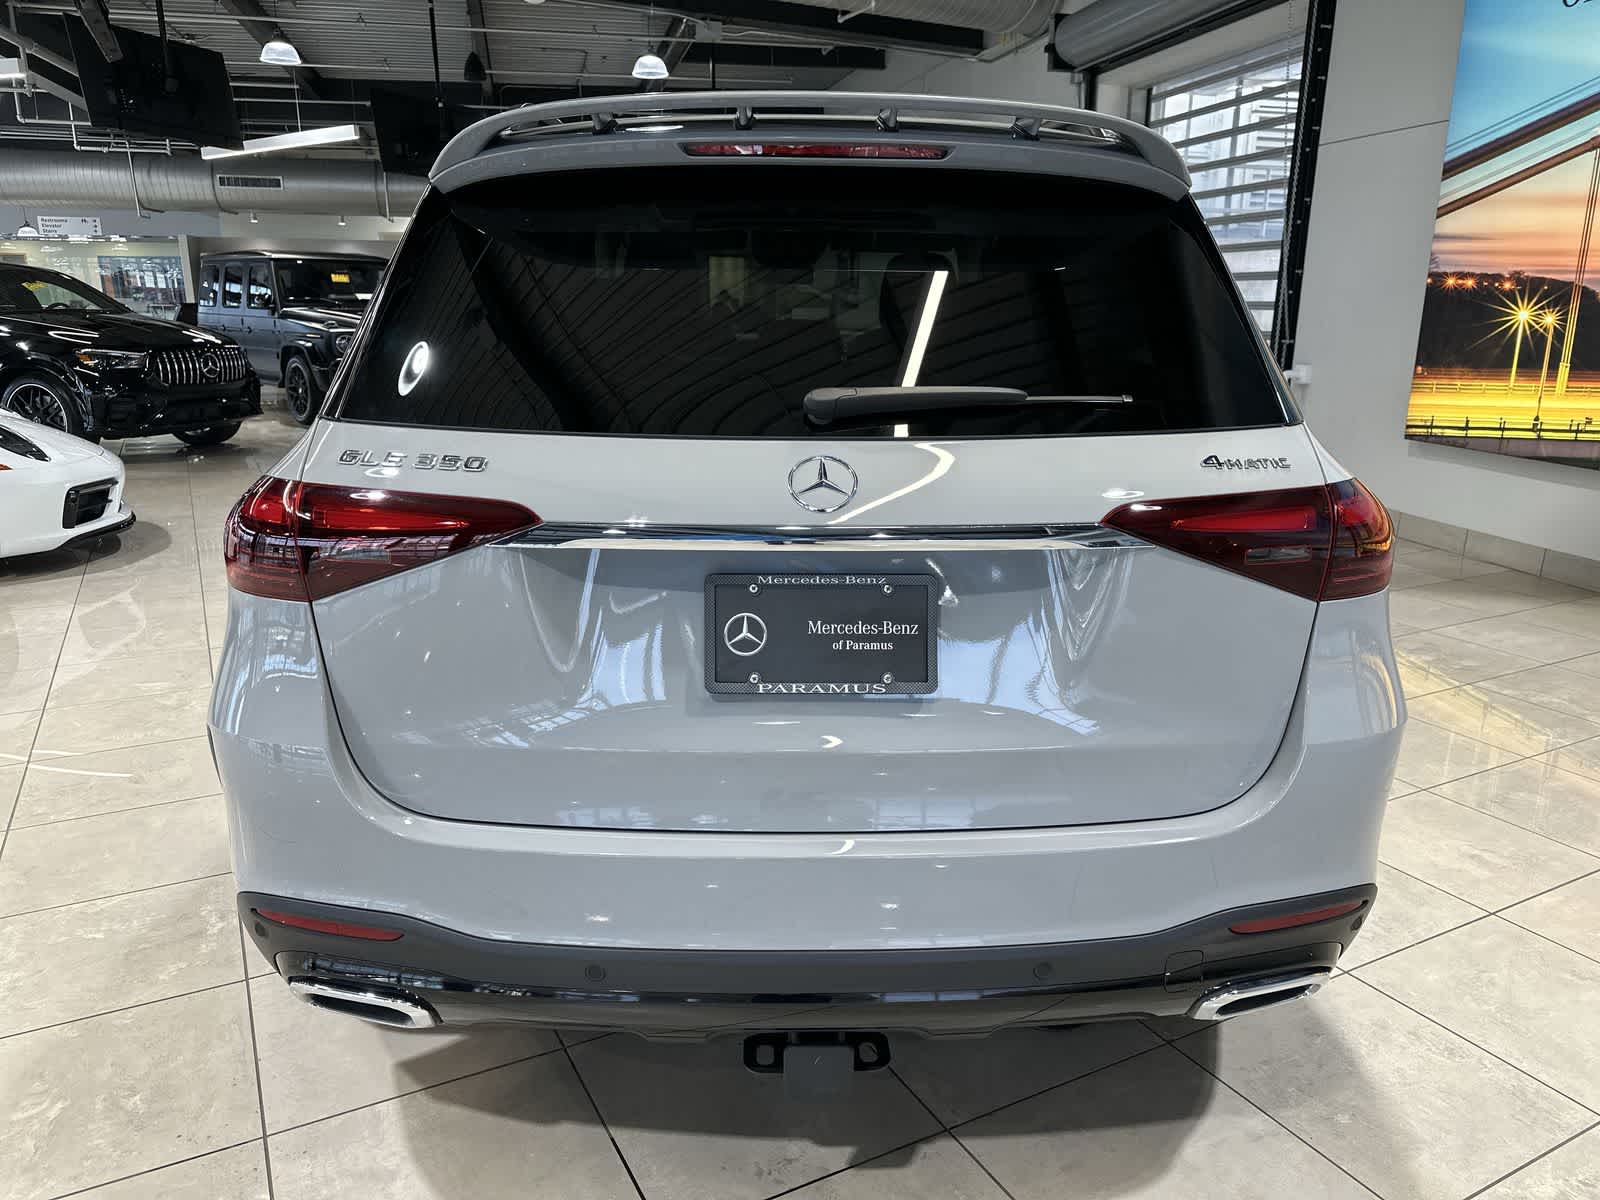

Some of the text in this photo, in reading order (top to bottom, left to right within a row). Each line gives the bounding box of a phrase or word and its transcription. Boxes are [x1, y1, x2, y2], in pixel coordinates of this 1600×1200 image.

[338, 449, 489, 472] GLE 350
[1200, 454, 1292, 470] 4MATIC
[757, 575, 887, 585] Mercedes-Benz
[807, 620, 919, 636] Mercedes-Benz
[832, 640, 894, 651] of Paramus
[757, 682, 887, 695] PARAMUS
